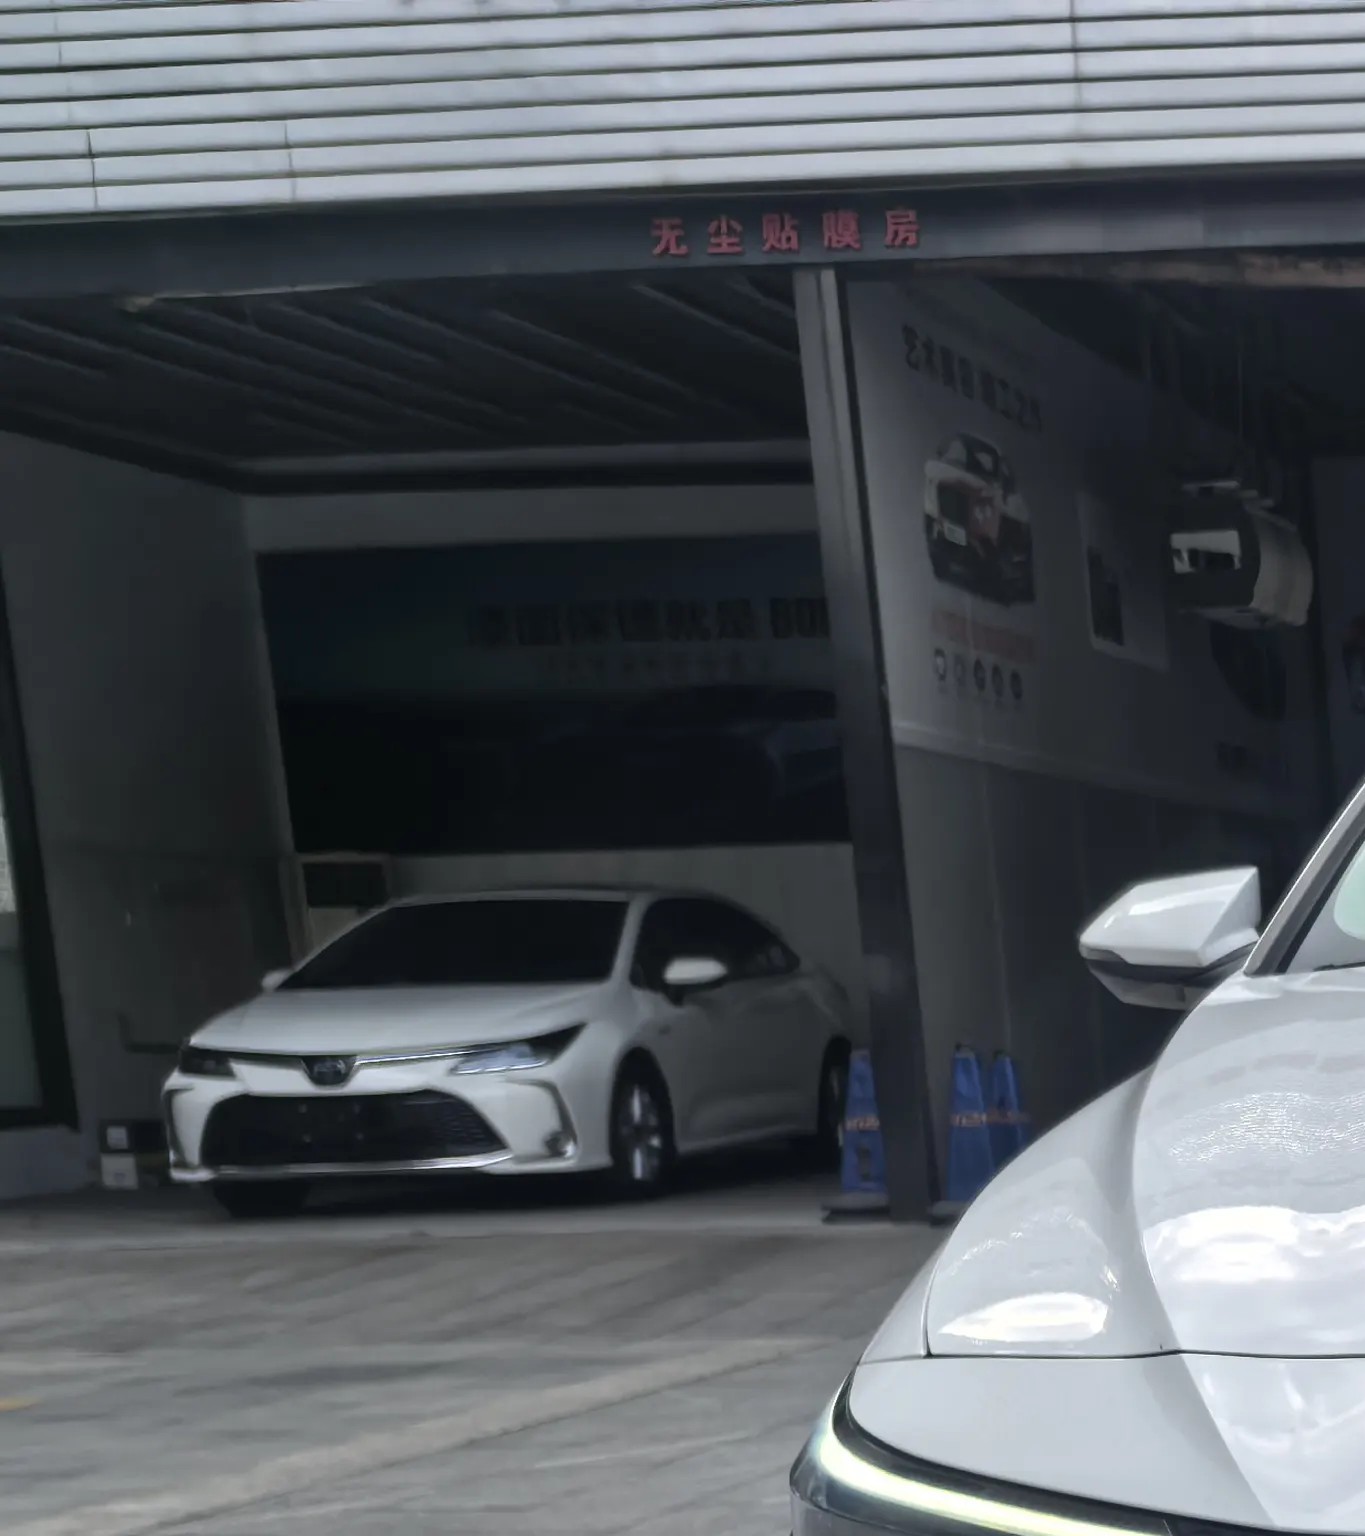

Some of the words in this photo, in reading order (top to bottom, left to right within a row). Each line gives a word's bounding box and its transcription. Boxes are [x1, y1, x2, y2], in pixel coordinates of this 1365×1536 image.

[650, 208, 922, 258] 无尘贴膜房
